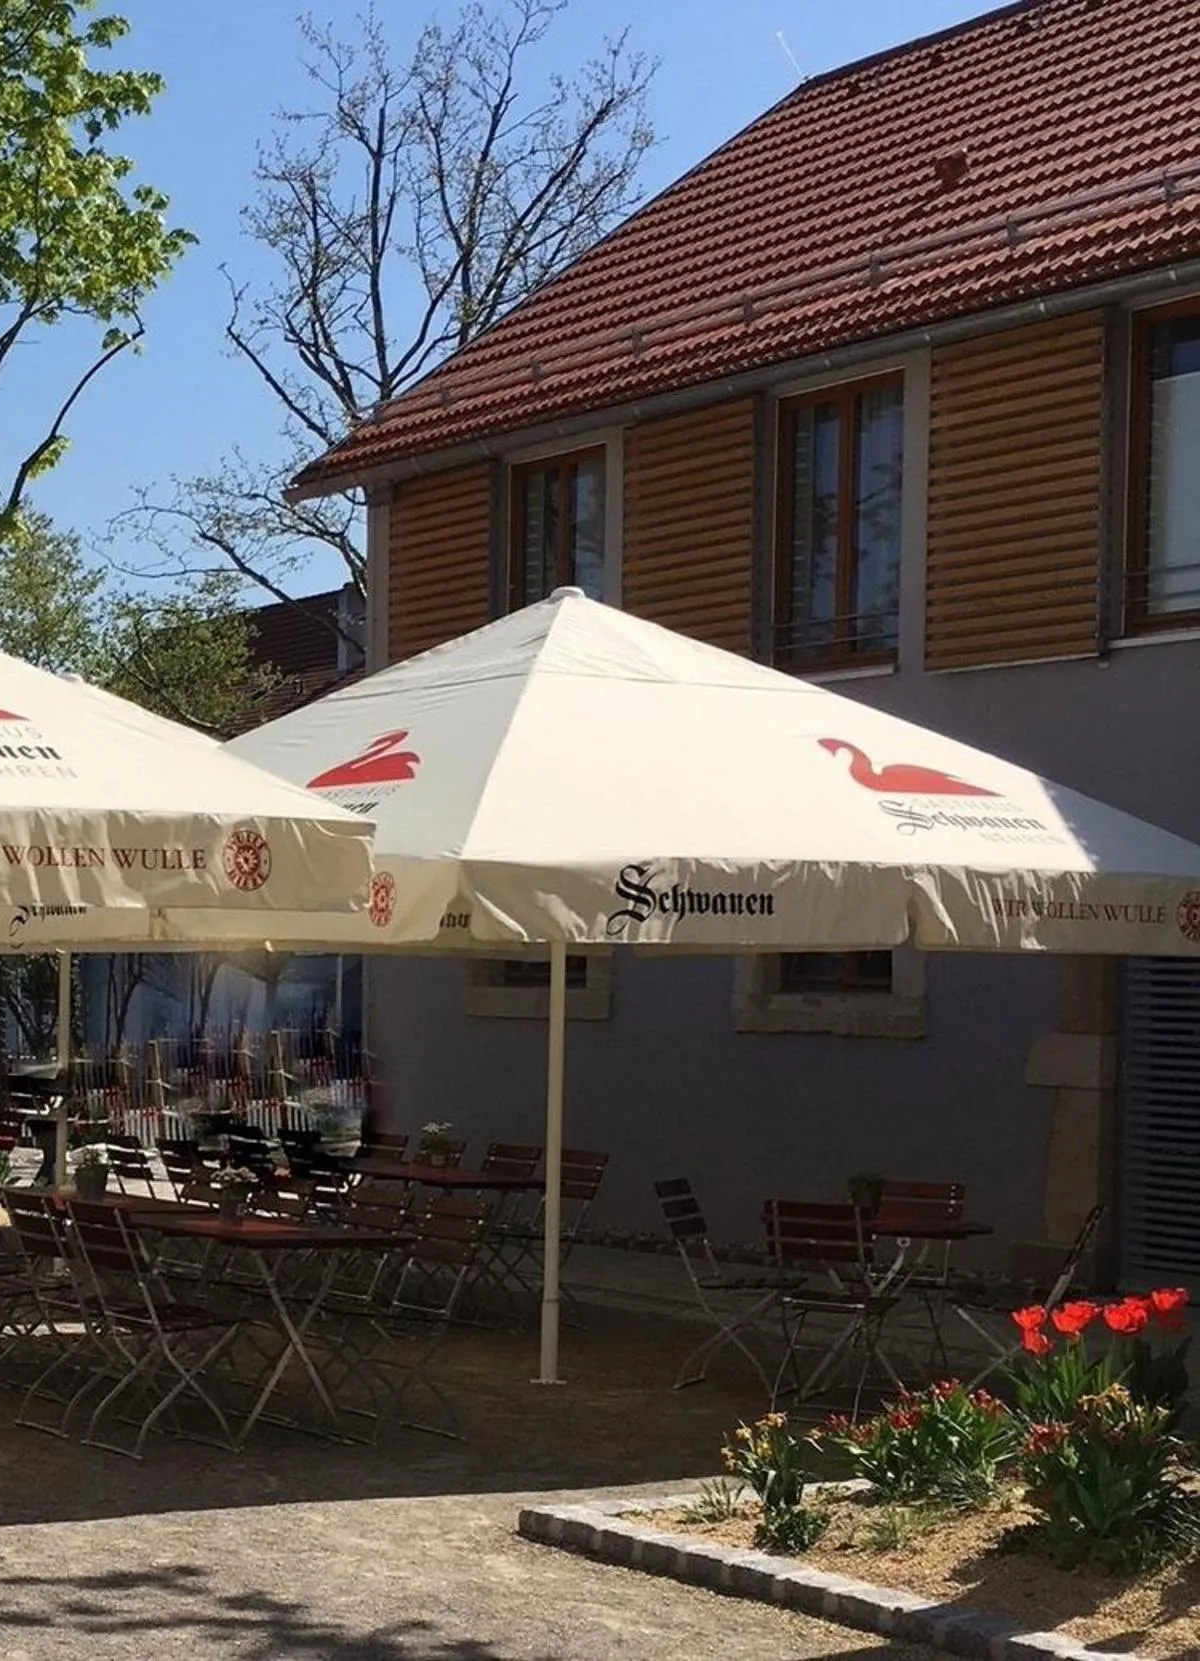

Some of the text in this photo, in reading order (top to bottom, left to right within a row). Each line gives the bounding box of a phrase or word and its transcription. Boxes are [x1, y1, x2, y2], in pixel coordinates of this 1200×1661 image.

[878, 799, 1047, 836] Schwanen
[1, 844, 105, 869] WOLLEN
[112, 847, 207, 871] WULLE
[606, 864, 775, 936] Schwanen
[992, 898, 1167, 924] WIR WOLLEN WULLE
